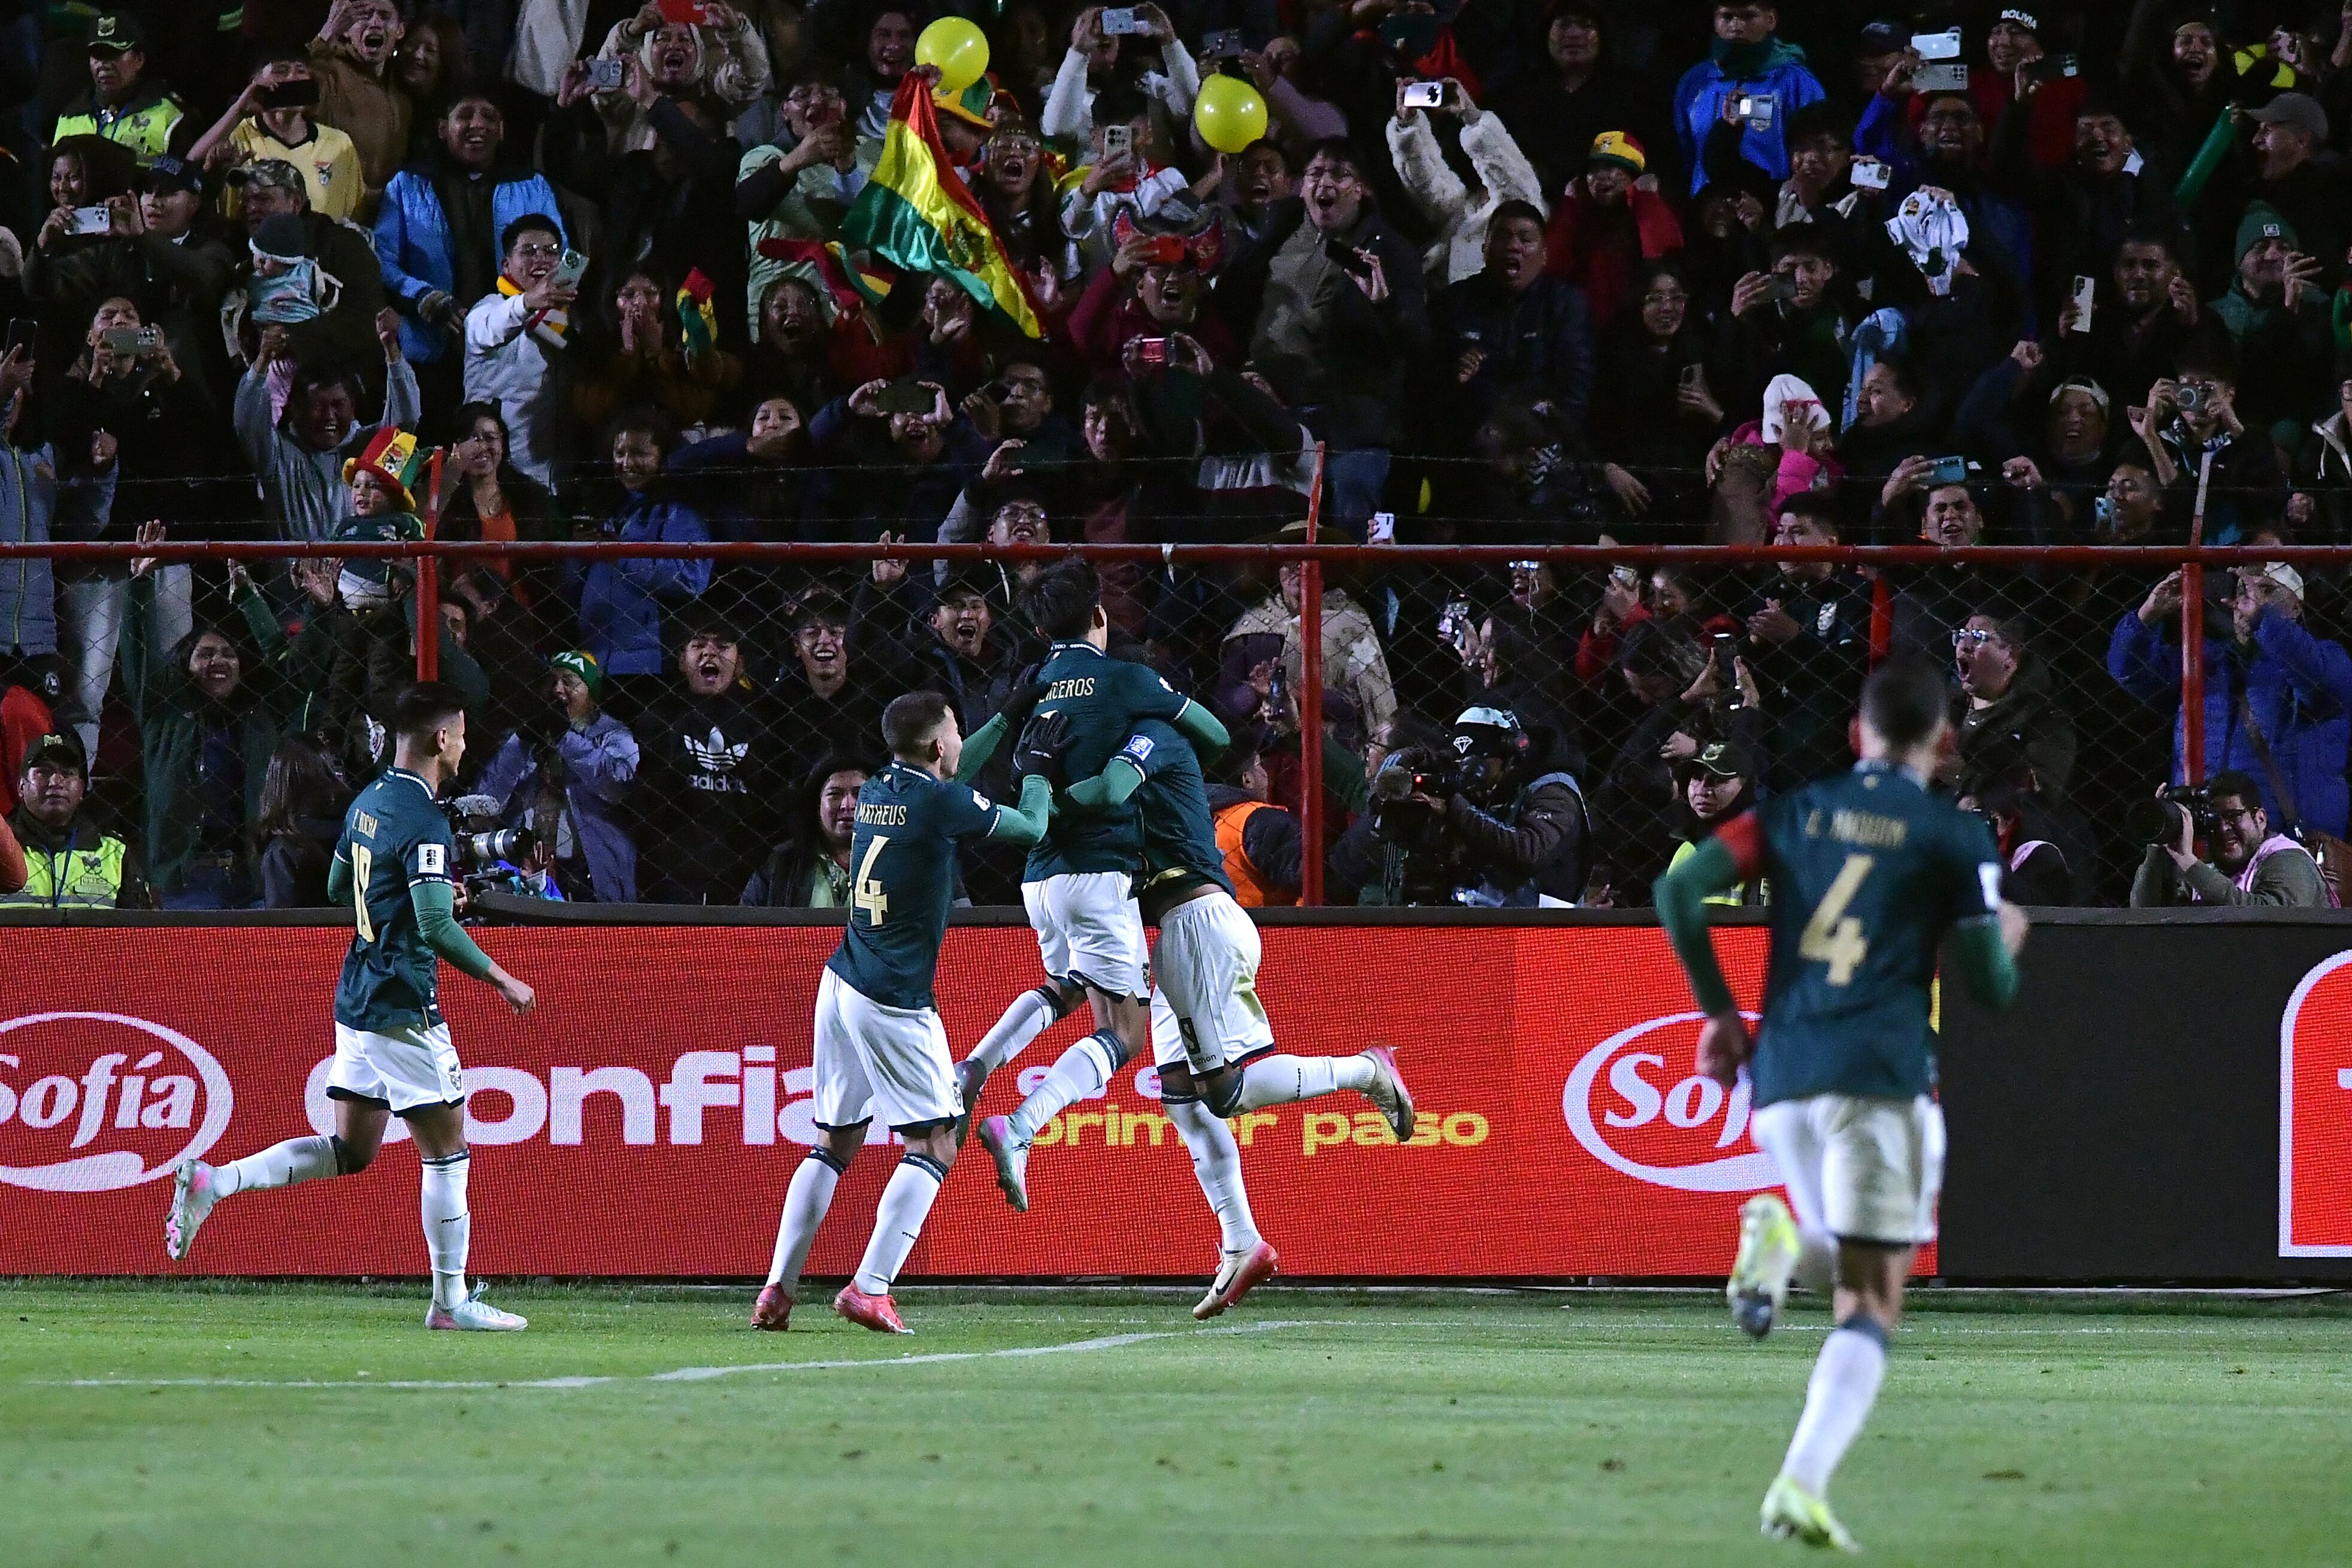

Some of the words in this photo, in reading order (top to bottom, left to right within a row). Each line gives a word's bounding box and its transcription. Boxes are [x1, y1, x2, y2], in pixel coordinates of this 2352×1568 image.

[2001, 9, 2037, 29] BOLIVIA
[1038, 677, 1095, 703] CEROS
[856, 802, 907, 826] MATHEUS
[1799, 855, 1875, 986] 4
[1303, 1112, 1490, 1156] paso
